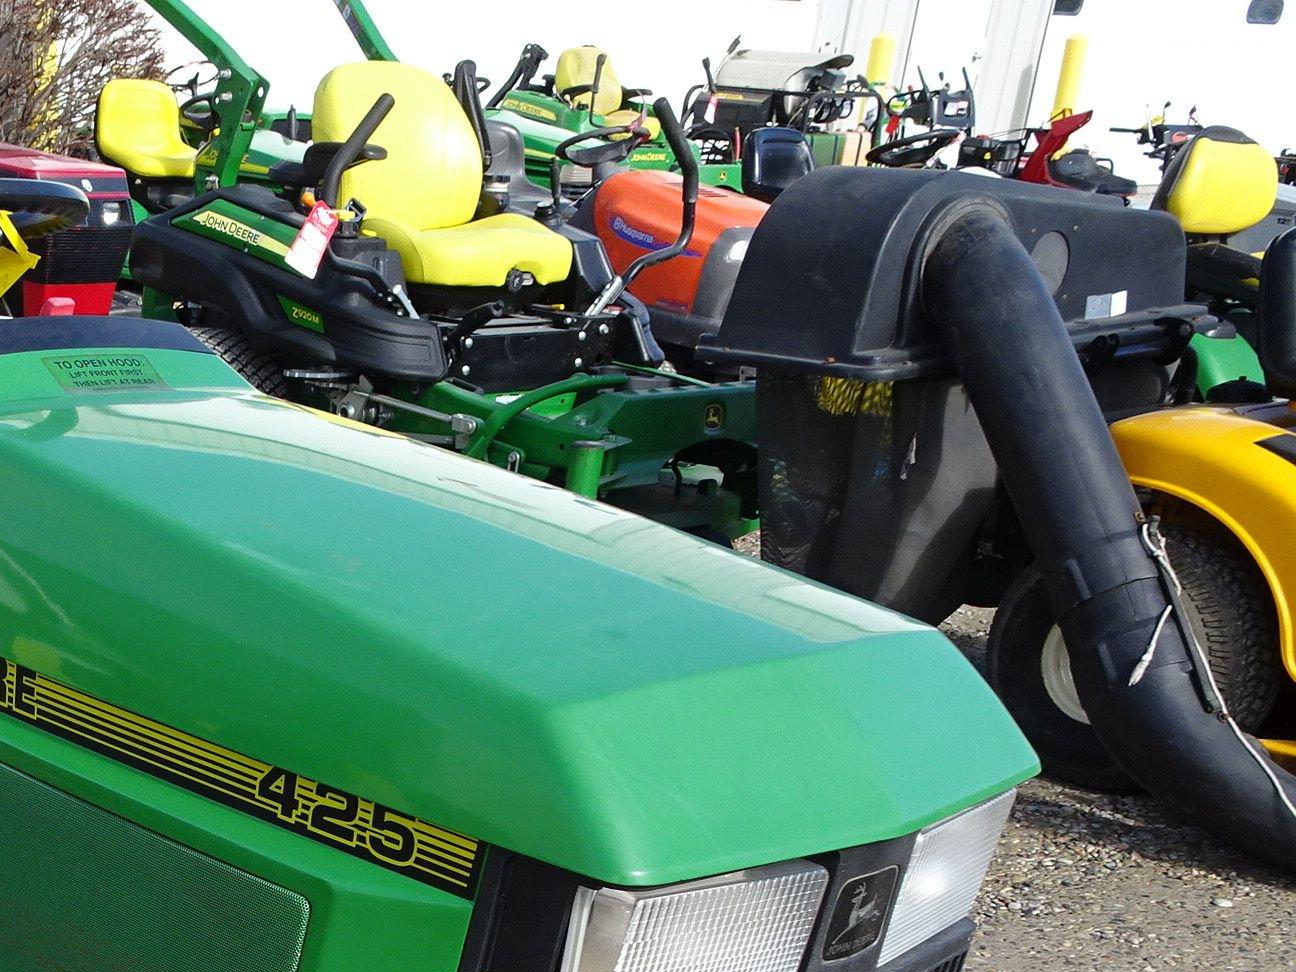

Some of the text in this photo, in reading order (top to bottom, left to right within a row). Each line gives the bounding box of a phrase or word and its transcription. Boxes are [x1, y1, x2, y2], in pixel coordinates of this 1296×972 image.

[204, 213, 261, 245] JOHN DEERE
[618, 219, 654, 244] Husqvarna
[291, 307, 320, 324] Z920M
[54, 358, 145, 370] TO OPEN HOOD:
[68, 370, 90, 379] LIFT
[89, 370, 118, 378] FRONT
[73, 380, 99, 388] THEN
[255, 766, 419, 867] 425
